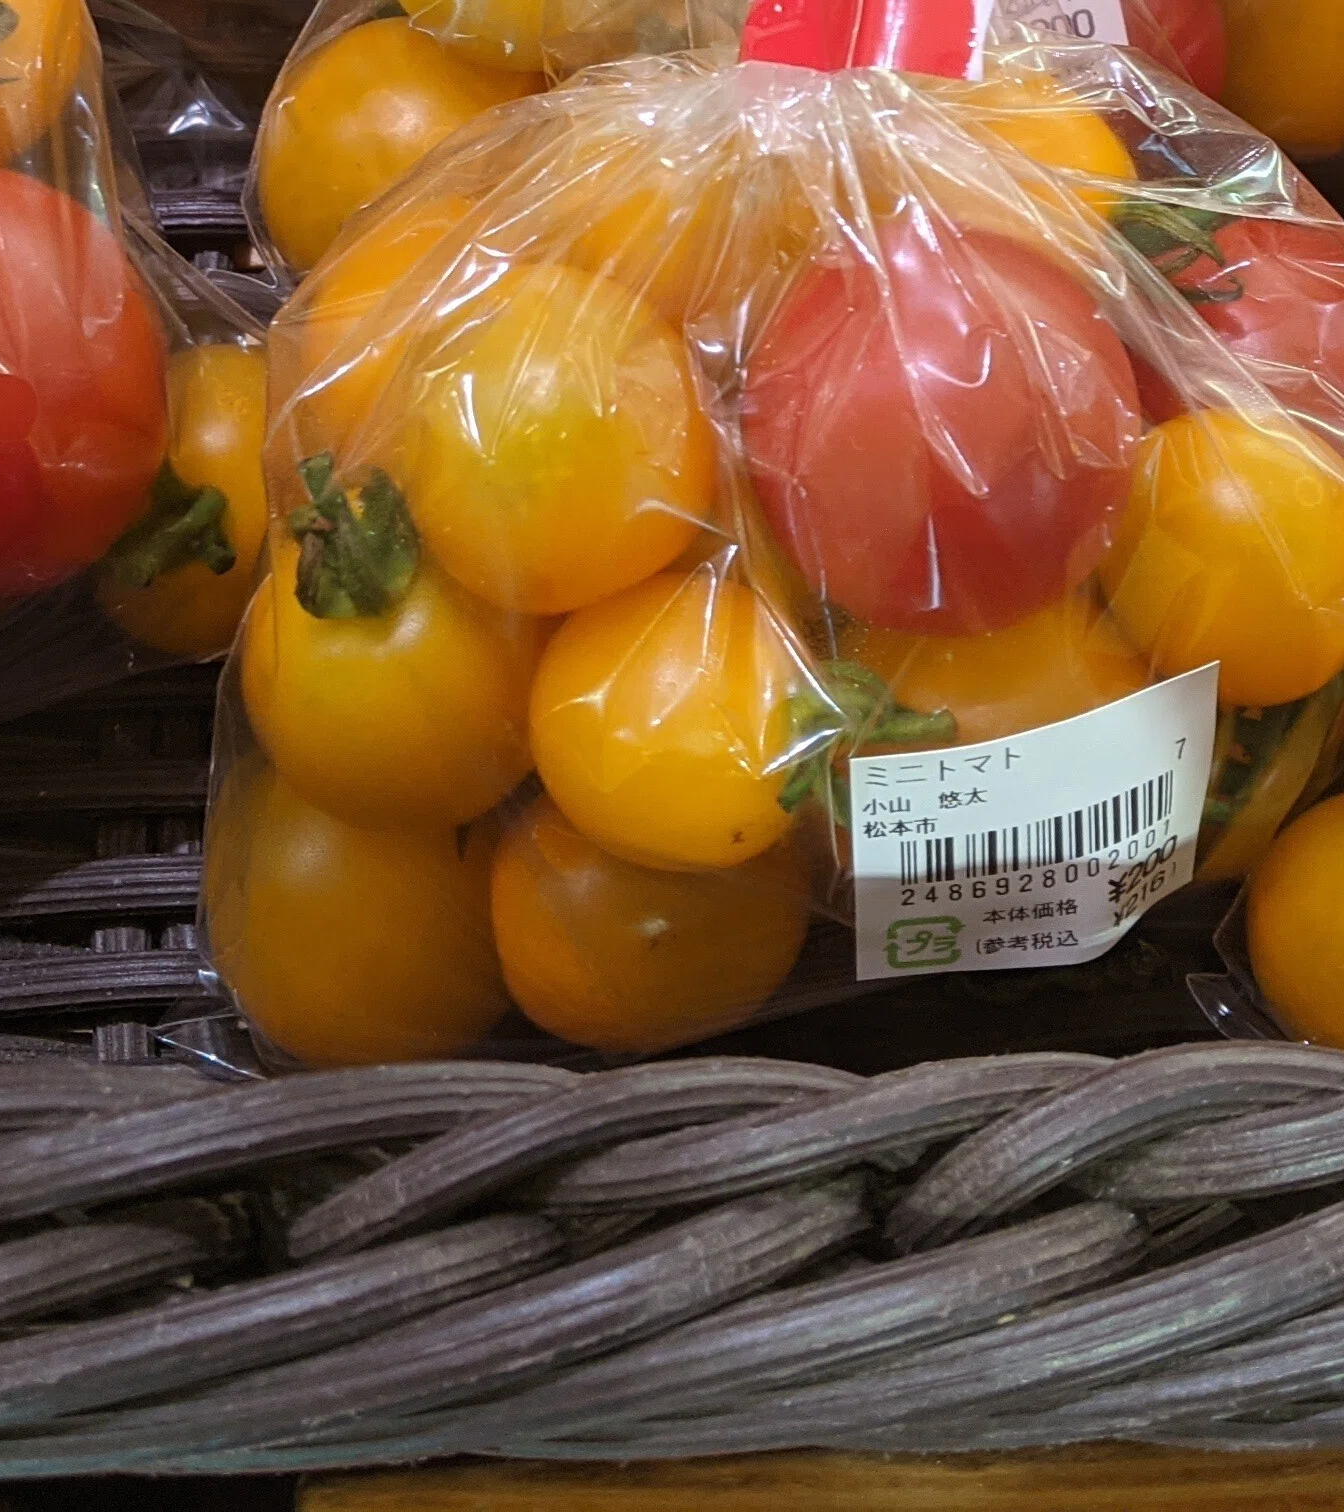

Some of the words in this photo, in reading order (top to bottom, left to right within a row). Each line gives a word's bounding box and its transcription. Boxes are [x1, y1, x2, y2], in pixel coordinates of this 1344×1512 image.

[1174, 737, 1188, 761] 7
[865, 747, 1023, 788] ミニトマト
[862, 796, 911, 817] 小山
[938, 787, 988, 810] 悠太
[862, 817, 939, 839] 松本市
[900, 818, 1170, 907] 2486928002001
[982, 899, 1080, 925] 本体価格
[1108, 835, 1178, 904] ¥200
